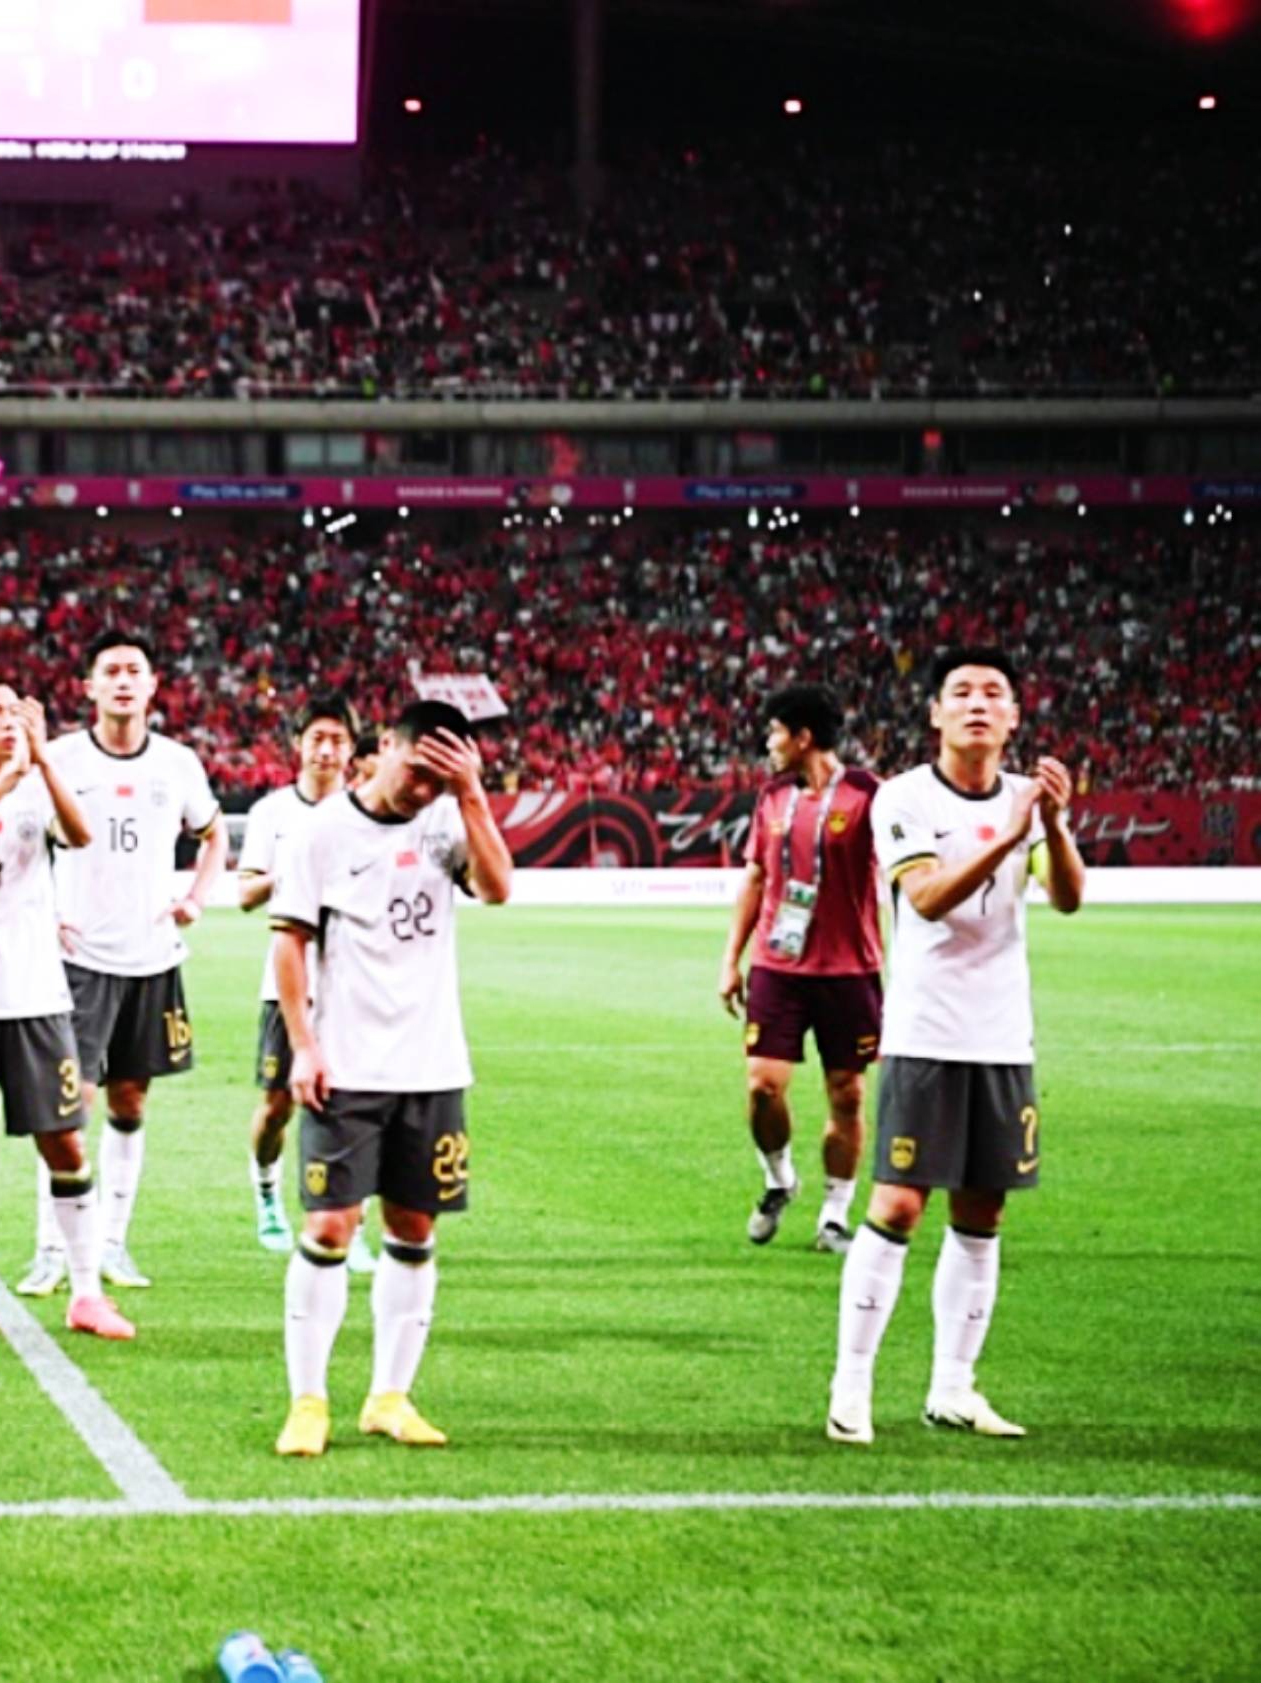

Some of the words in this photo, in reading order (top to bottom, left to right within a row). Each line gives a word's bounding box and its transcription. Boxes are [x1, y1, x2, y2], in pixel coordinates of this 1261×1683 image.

[122, 56, 157, 100] 0
[109, 817, 138, 852] 16
[388, 891, 436, 942] 22
[163, 1008, 193, 1049] 16
[58, 1058, 80, 1100] 3
[1019, 1106, 1038, 1155] 7
[433, 1131, 471, 1184] 22
